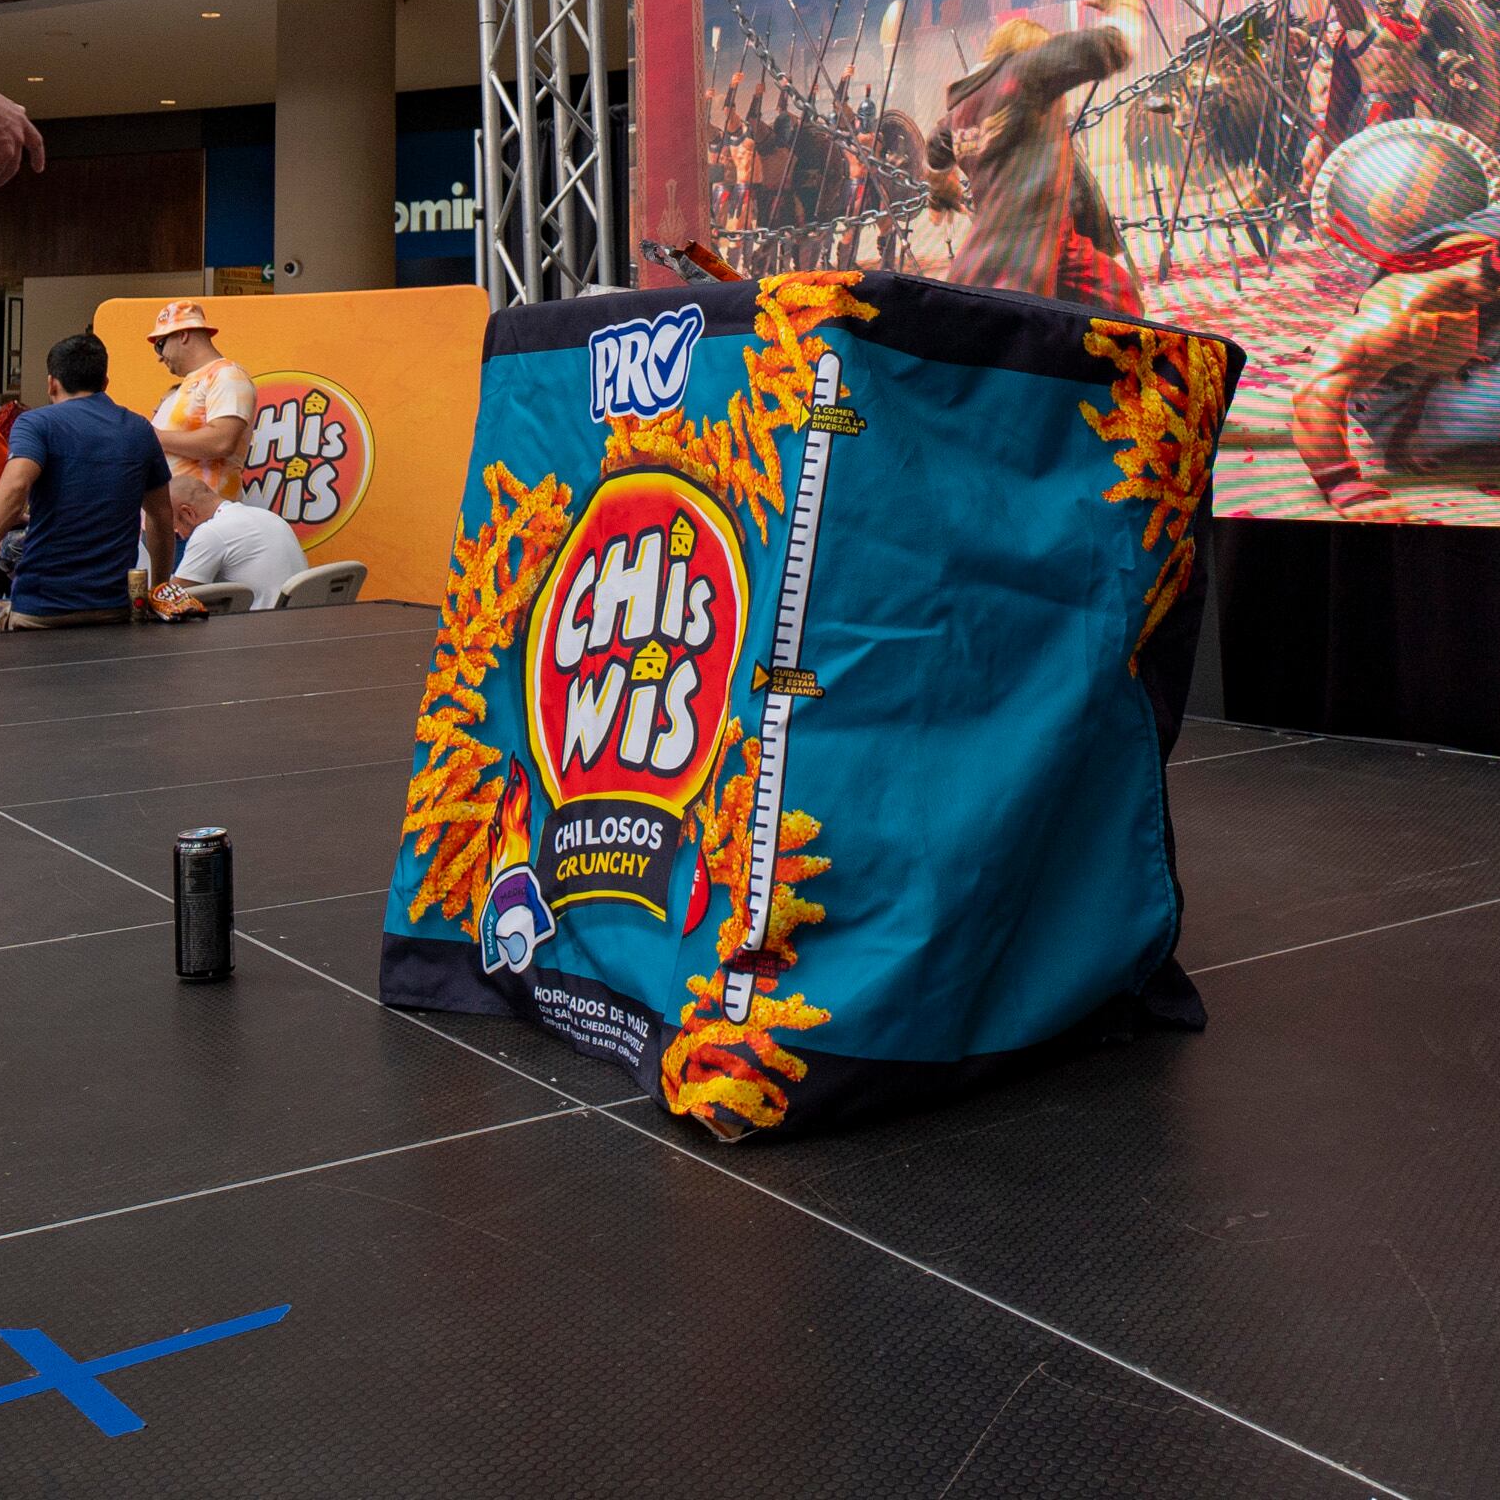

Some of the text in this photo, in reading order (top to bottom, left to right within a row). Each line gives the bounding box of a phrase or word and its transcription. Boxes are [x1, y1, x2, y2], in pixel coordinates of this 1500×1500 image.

[593, 314, 699, 412] PRO
[813, 414, 866, 428] EMPIEZA LA
[772, 677, 784, 685] SE
[773, 669, 815, 680] CUIDADO
[771, 685, 824, 697] ACABANDO
[554, 816, 664, 854] CHILOSOS
[556, 851, 651, 881] CRUNCHY
[487, 914, 495, 955] SUAVE
[610, 1005, 625, 1024] DE
[580, 1018, 621, 1038] CHEDDAR
[592, 1036, 617, 1050] BAKED
